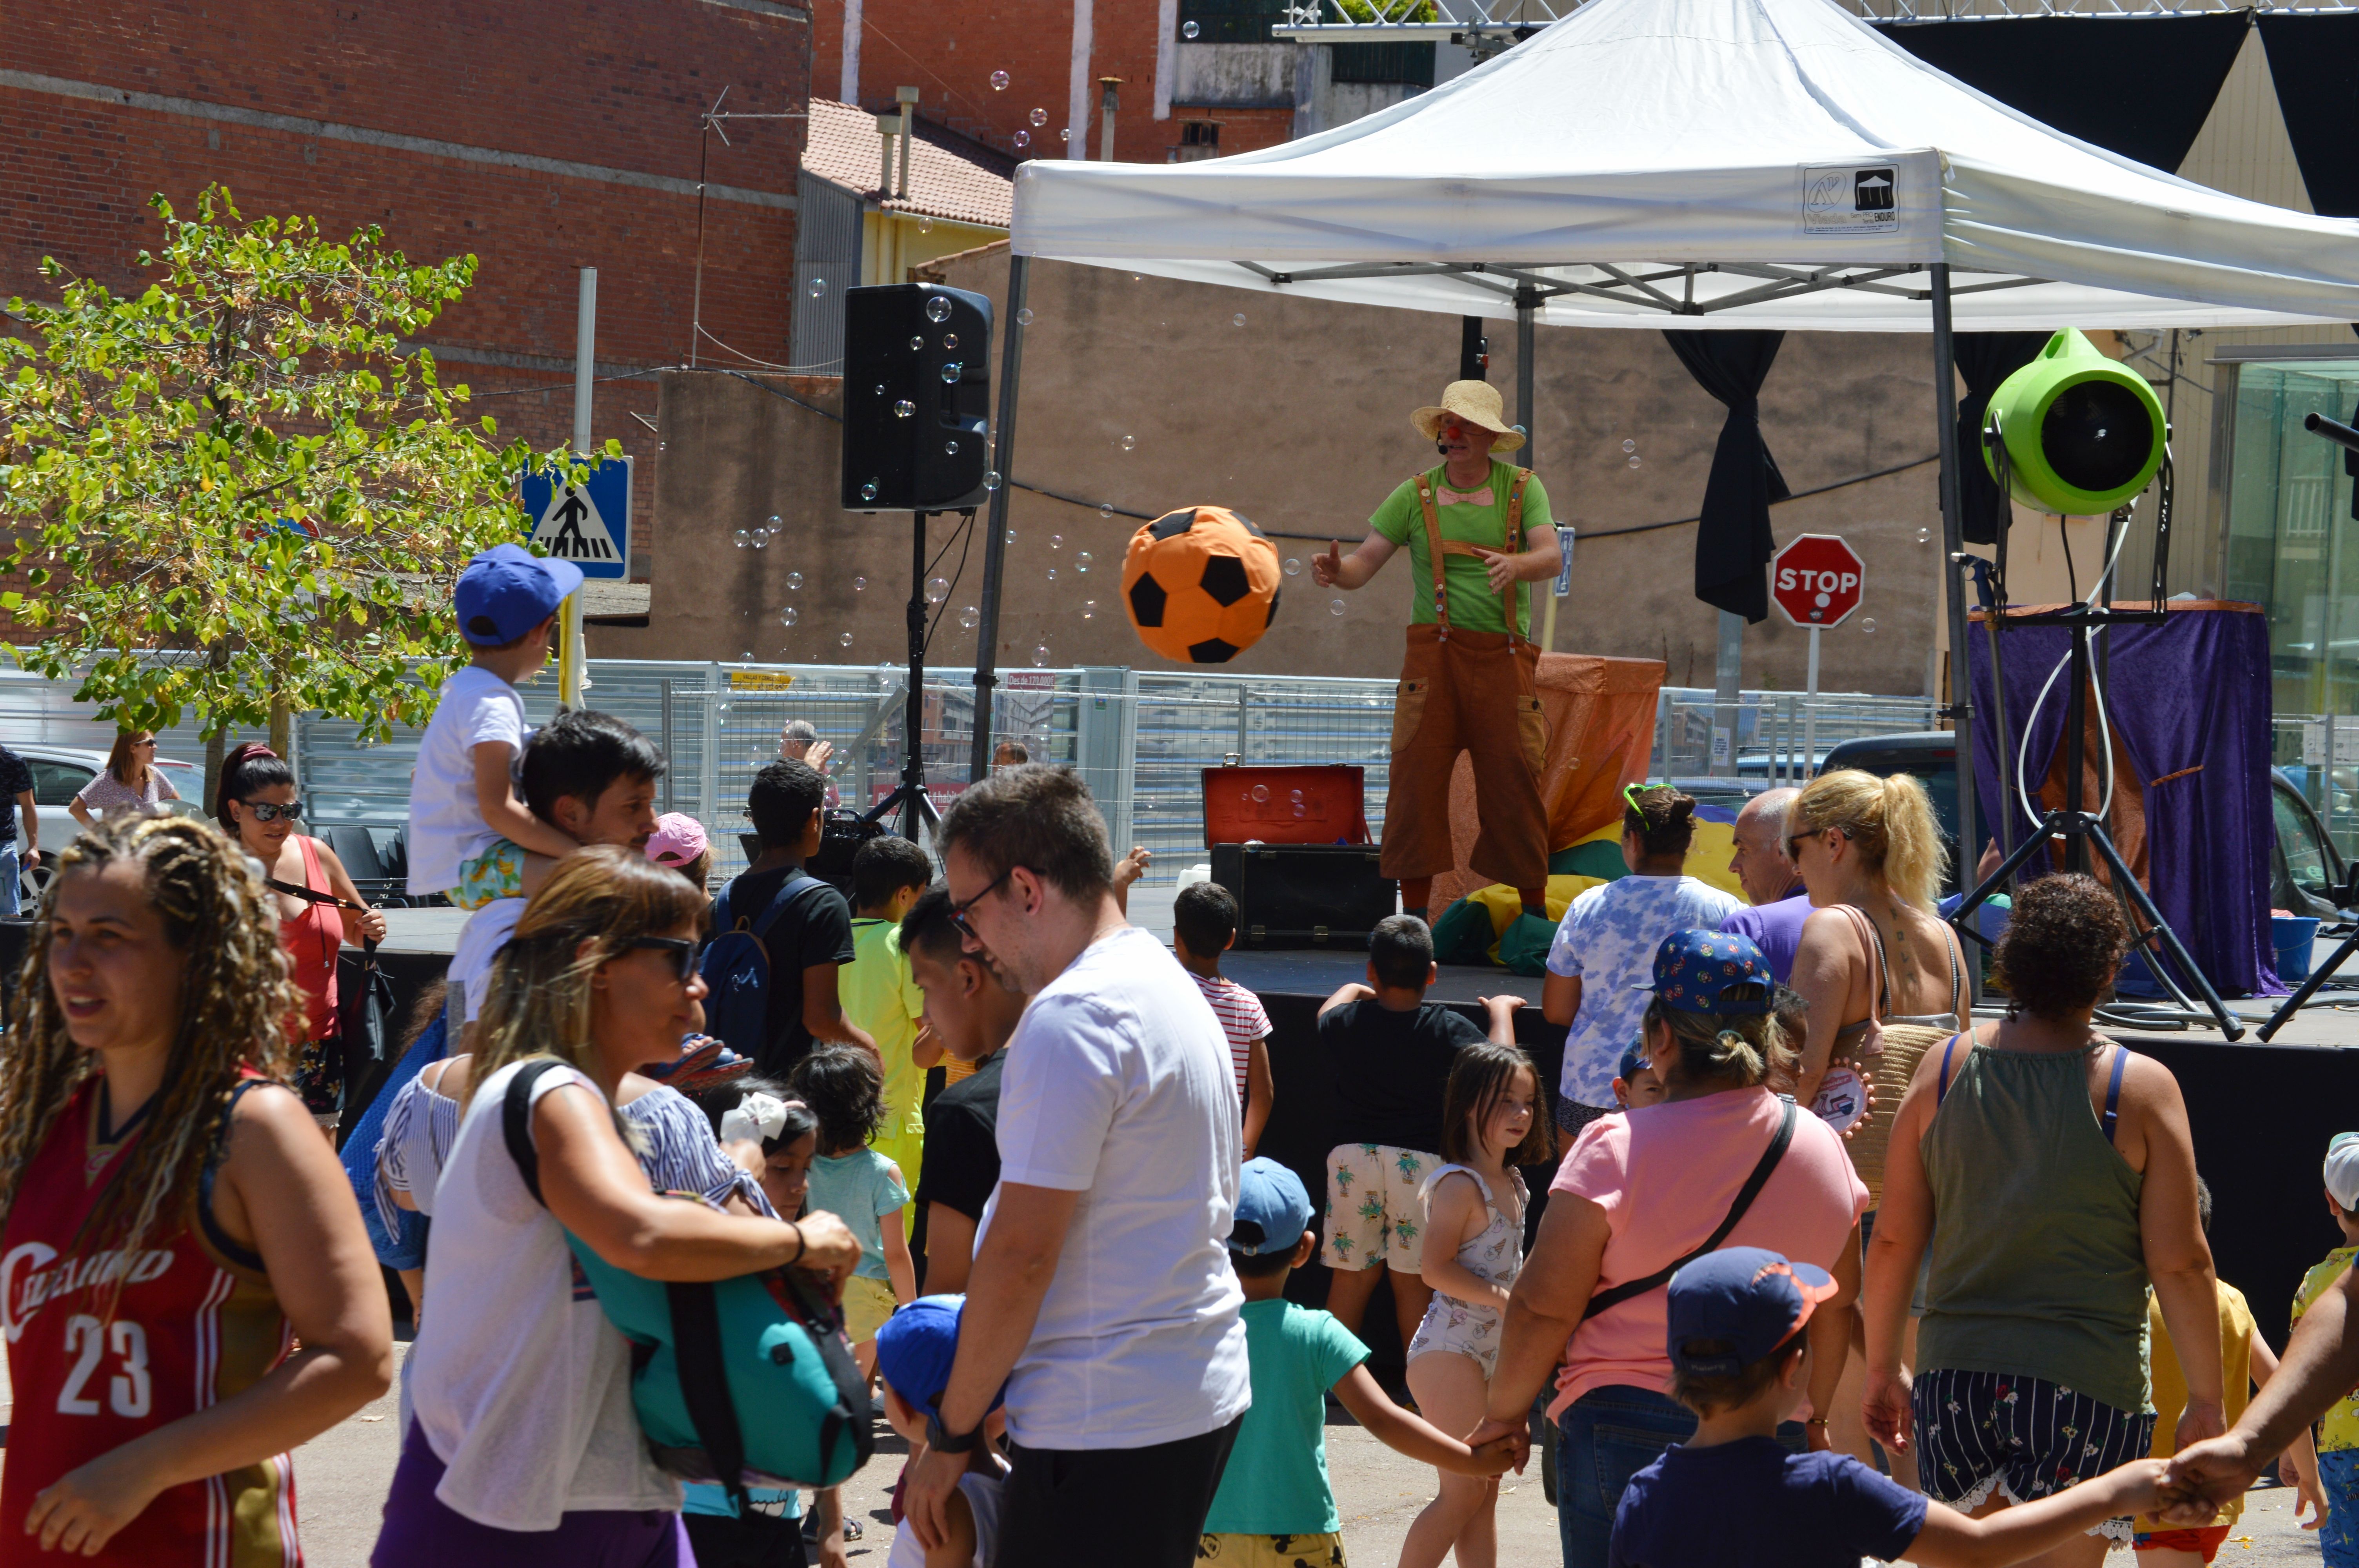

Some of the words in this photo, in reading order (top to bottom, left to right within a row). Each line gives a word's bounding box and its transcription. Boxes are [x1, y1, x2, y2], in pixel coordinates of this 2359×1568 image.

[1807, 213, 1847, 224] Viada
[1874, 211, 1895, 222] ENDURO
[1777, 568, 1858, 594] STOP
[56, 1314, 151, 1418] 23
